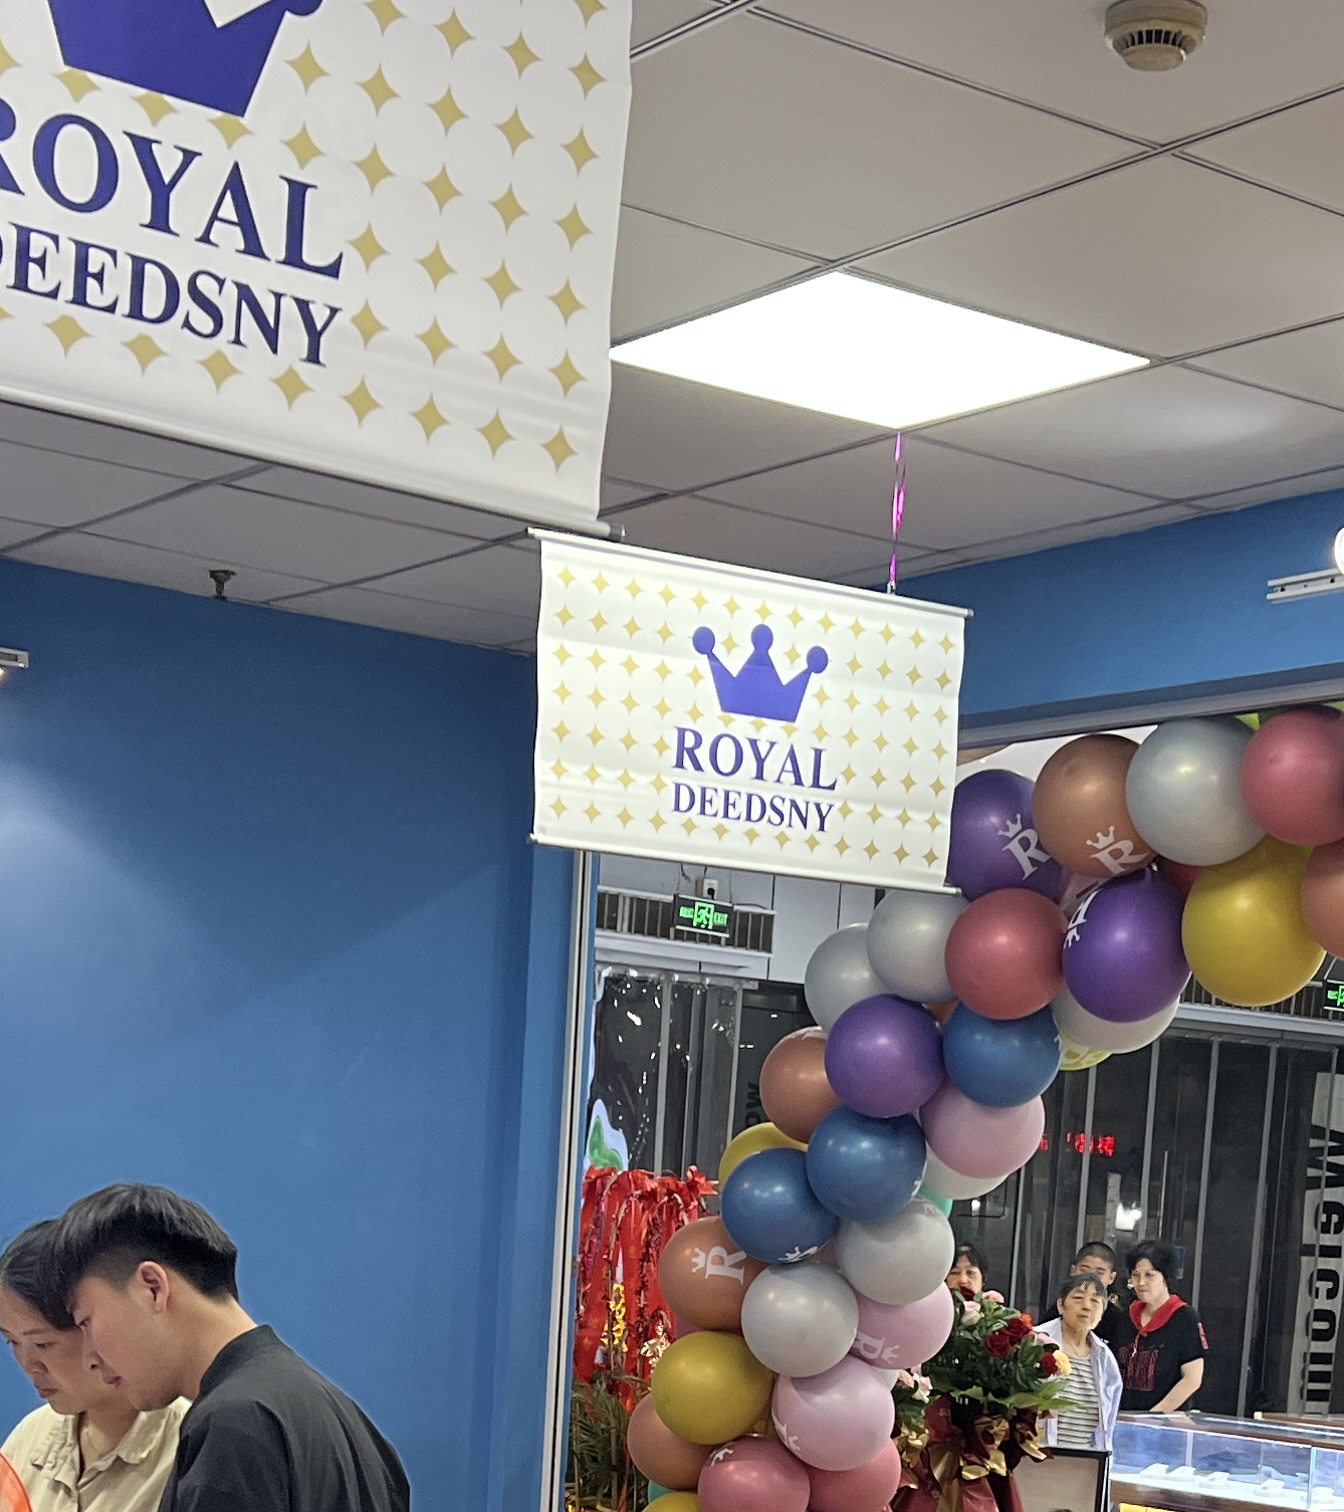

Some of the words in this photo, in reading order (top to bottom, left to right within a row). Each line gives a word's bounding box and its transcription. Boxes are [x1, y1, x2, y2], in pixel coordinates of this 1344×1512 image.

[672, 726, 838, 791] ROYAL
[672, 783, 836, 832] DEEDSNY
[704, 1246, 747, 1286] R
